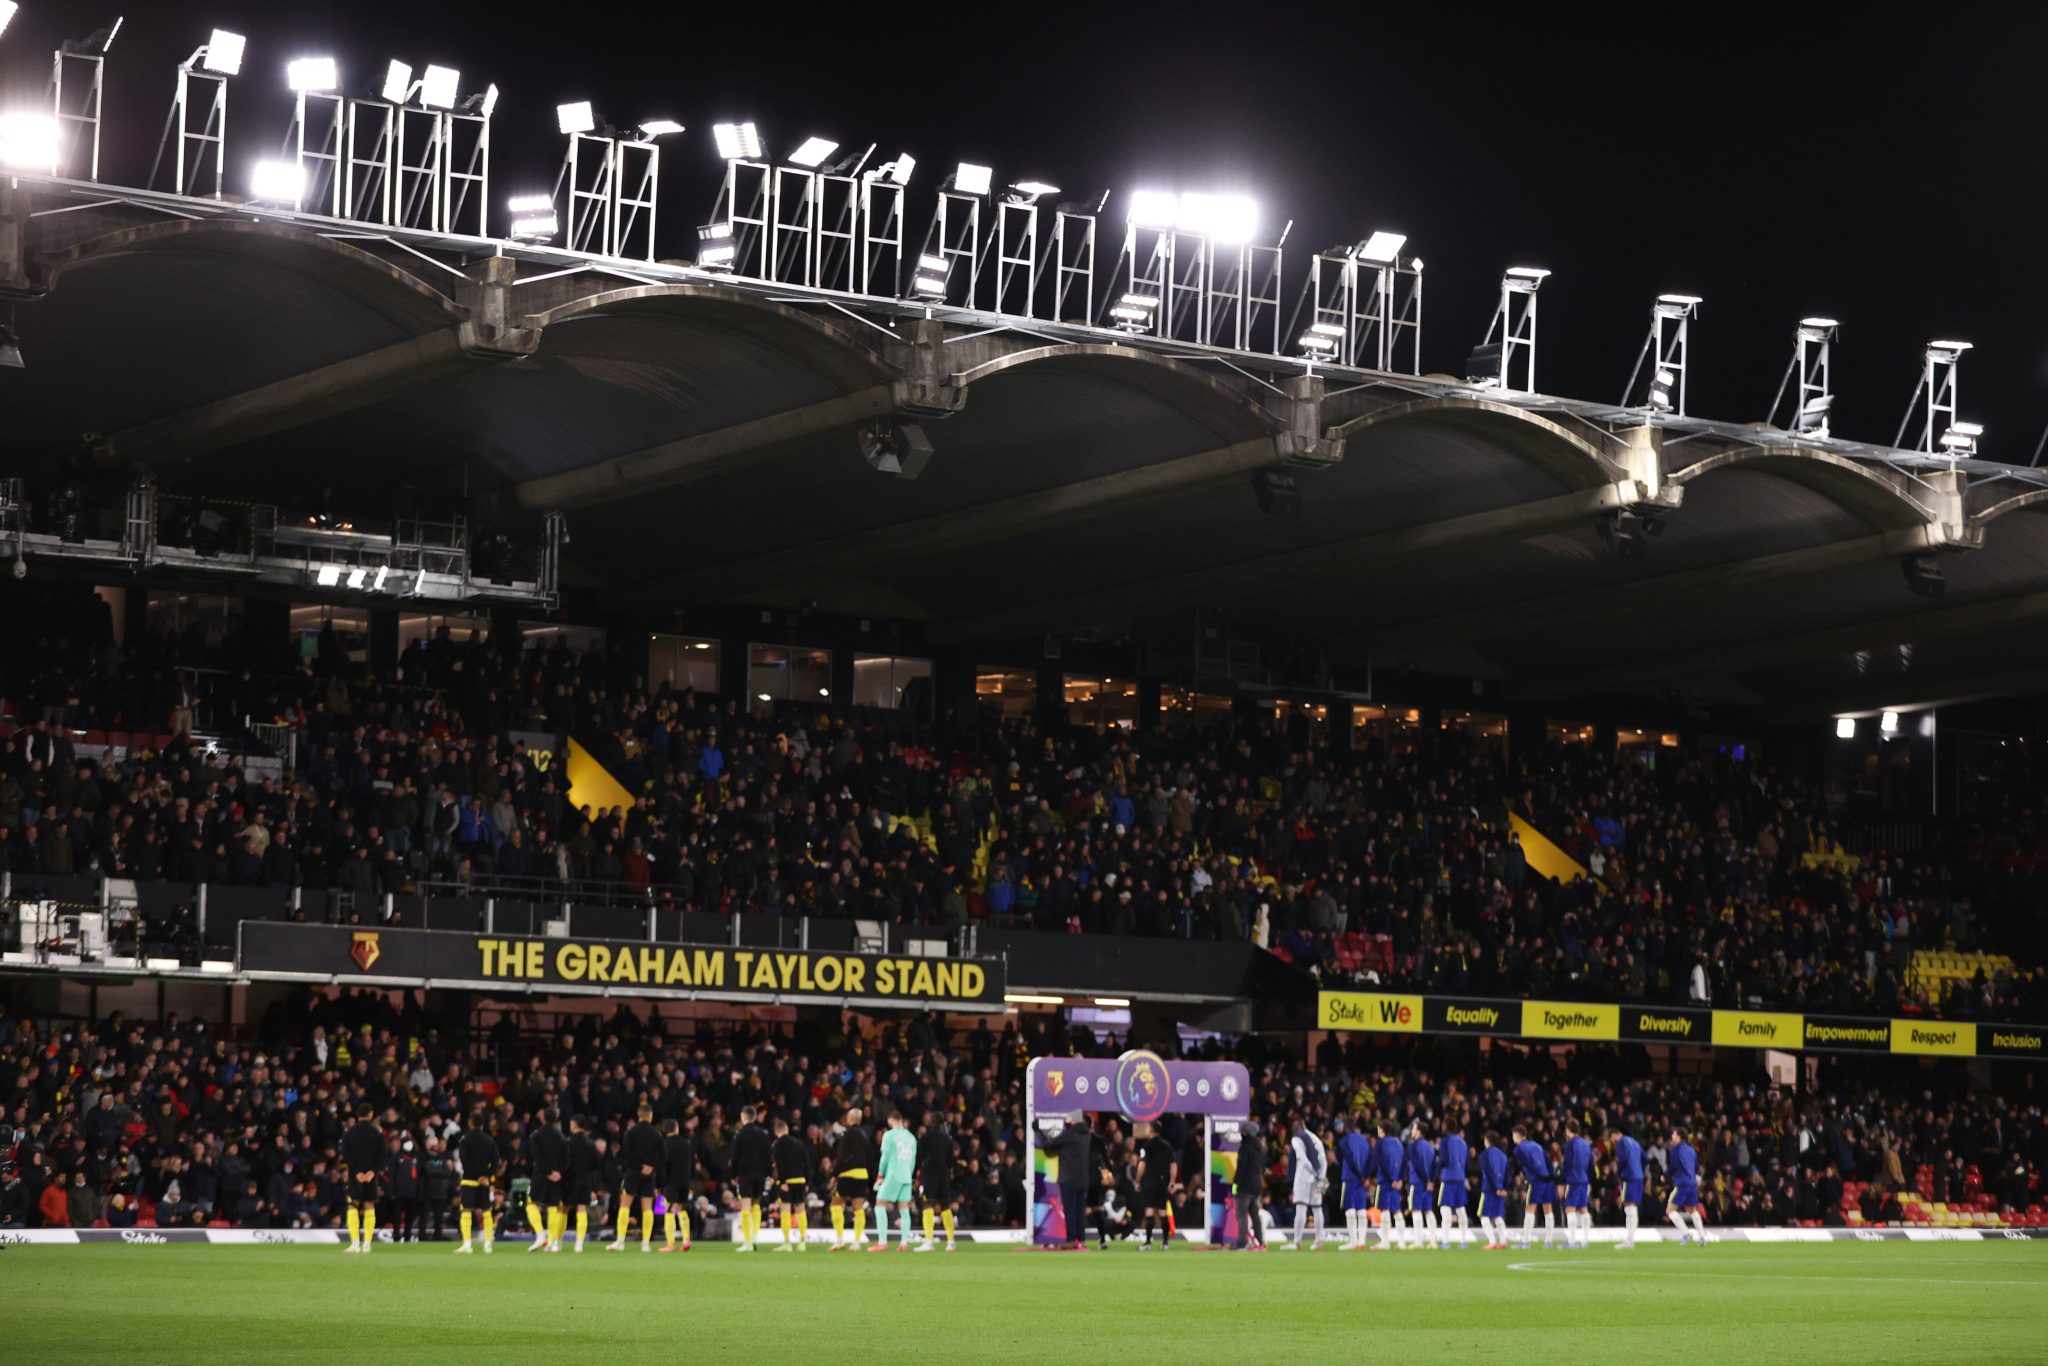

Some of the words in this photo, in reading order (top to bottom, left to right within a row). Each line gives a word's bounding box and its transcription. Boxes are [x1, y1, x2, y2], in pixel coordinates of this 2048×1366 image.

[478, 939, 545, 978] THE
[556, 943, 724, 986] GRAHAM
[734, 952, 866, 992] TAYLOR
[875, 959, 986, 998] STAND
[1329, 998, 1364, 1025] Stake
[1380, 1000, 1412, 1025] We
[1446, 1006, 1498, 1027] Equality
[1543, 1010, 1598, 1029] Together
[1640, 1014, 1691, 1035] Diversity
[1738, 1019, 1777, 1037] Family
[1806, 1023, 1888, 1043] Empowerment
[1911, 1029, 1957, 1047] Respect
[1993, 1032, 2041, 1049] Inclusion
[896, 1141, 913, 1159] 26
